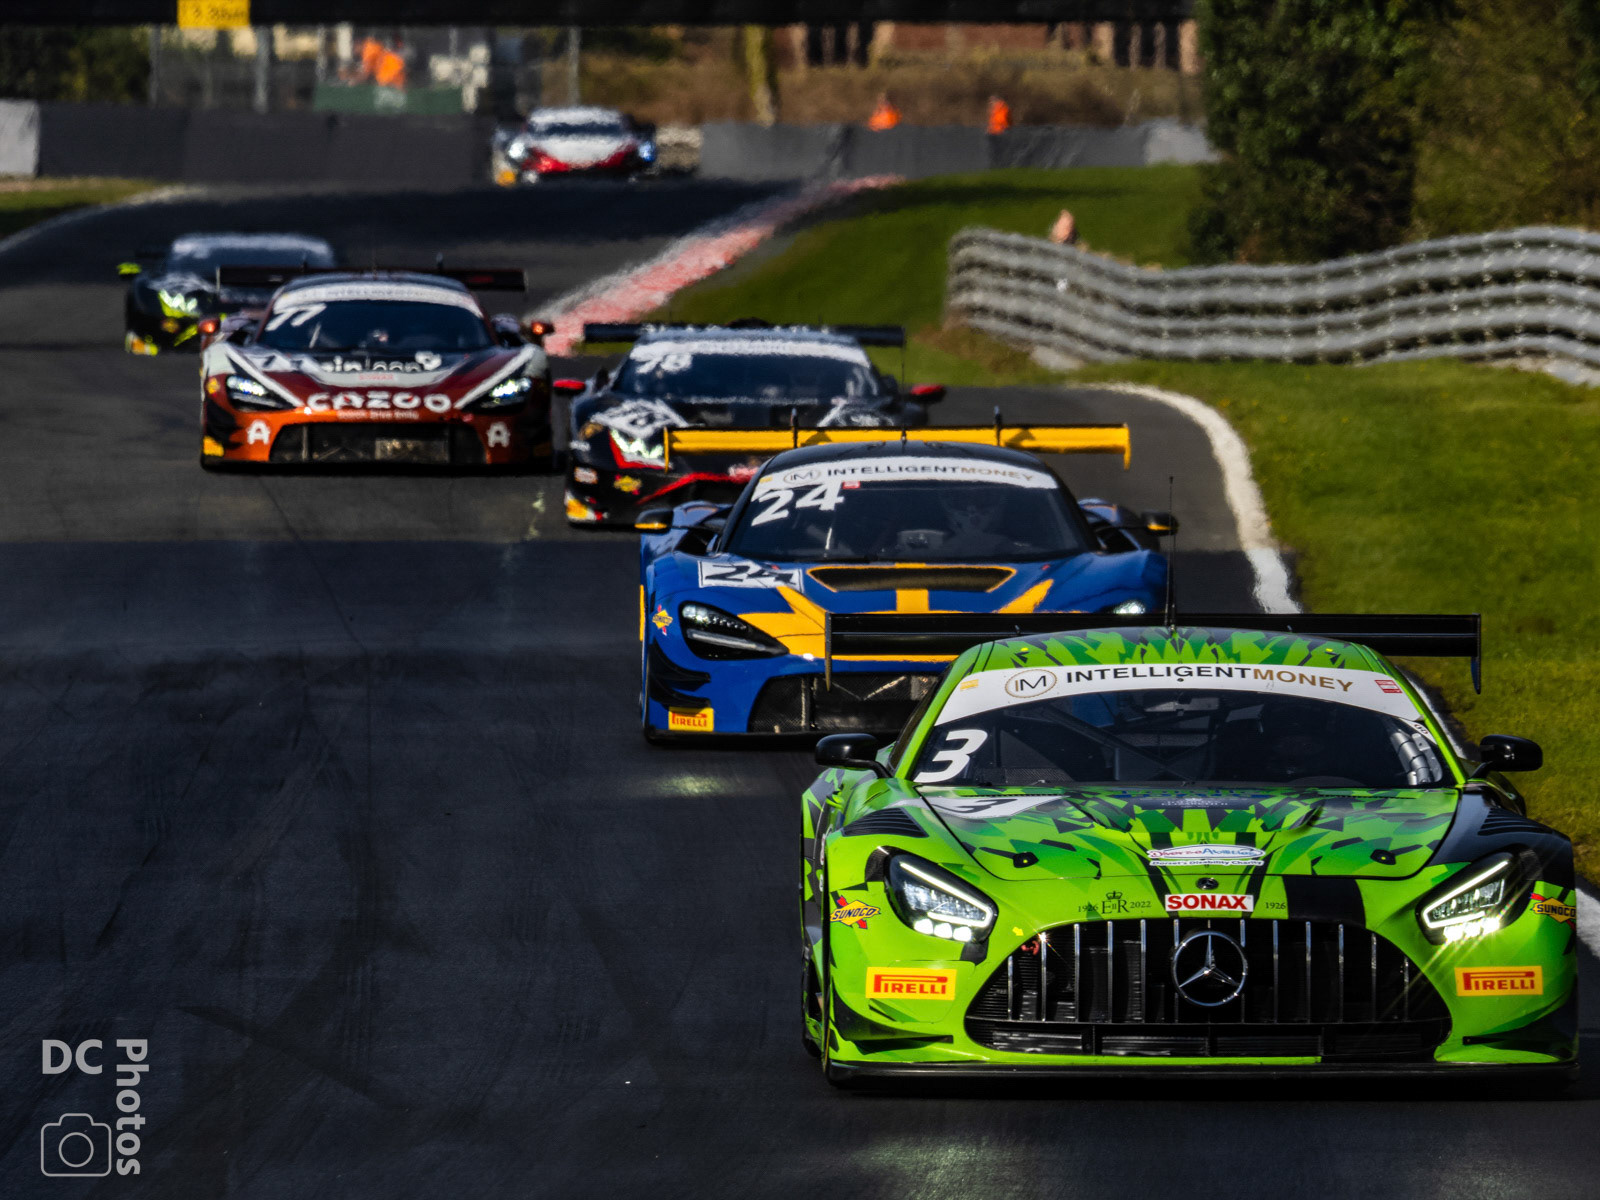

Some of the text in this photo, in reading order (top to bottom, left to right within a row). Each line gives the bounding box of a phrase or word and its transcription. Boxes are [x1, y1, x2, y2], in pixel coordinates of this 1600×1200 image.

[751, 477, 845, 527] 24
[671, 712, 707, 728] PIRELLI
[914, 728, 988, 782] 3
[1231, 858, 1264, 867] Charity
[1130, 901, 1152, 909] 2022
[1167, 895, 1248, 910] SONAX
[1265, 902, 1287, 910] 1926
[832, 907, 876, 921] SUNOCO
[1537, 904, 1576, 917] SUNOCO
[873, 974, 948, 995] PIRELLI
[1462, 971, 1535, 991] PIRELLI
